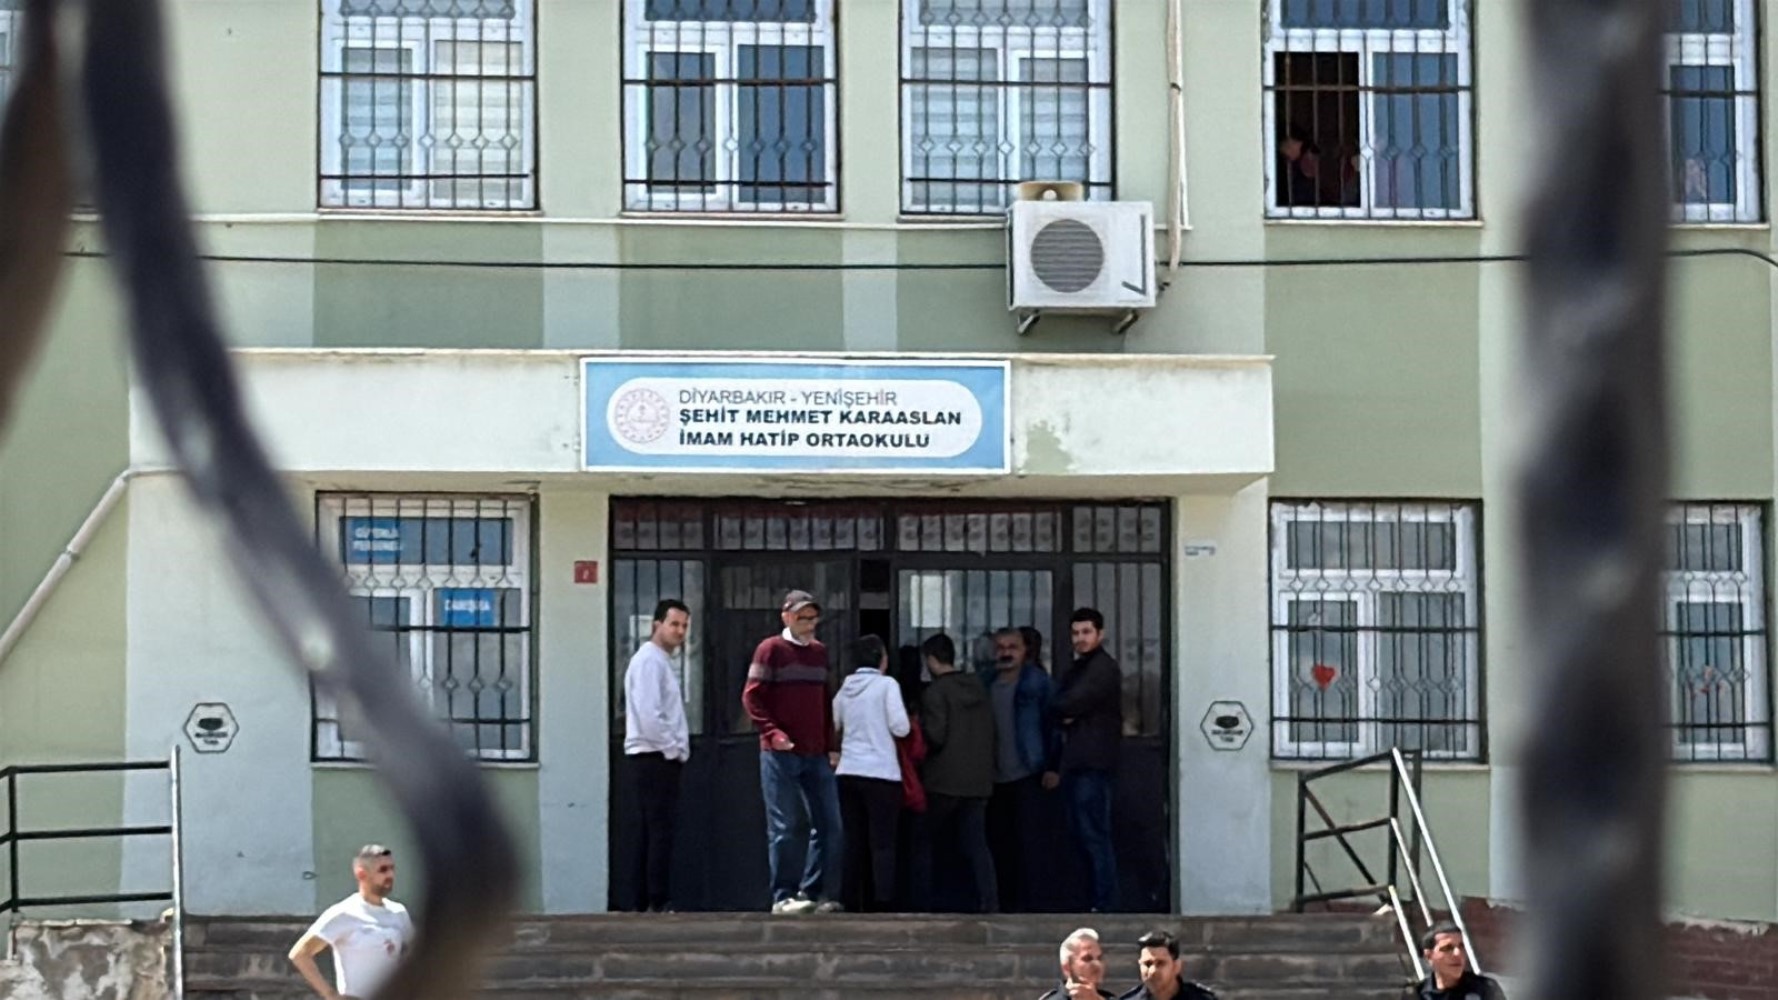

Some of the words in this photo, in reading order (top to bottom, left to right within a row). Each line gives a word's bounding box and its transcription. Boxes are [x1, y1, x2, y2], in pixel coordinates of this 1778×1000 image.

[679, 387, 786, 404] DİYARBAKIR
[801, 388, 898, 409] YENİŞEHİR
[679, 405, 740, 426] ŞEHİT
[746, 409, 834, 424] MEHMET
[839, 410, 962, 425] KARAASLAN
[679, 428, 733, 446] İMAM
[740, 429, 800, 447] HATİP
[806, 432, 930, 448] ORTAOKULU
